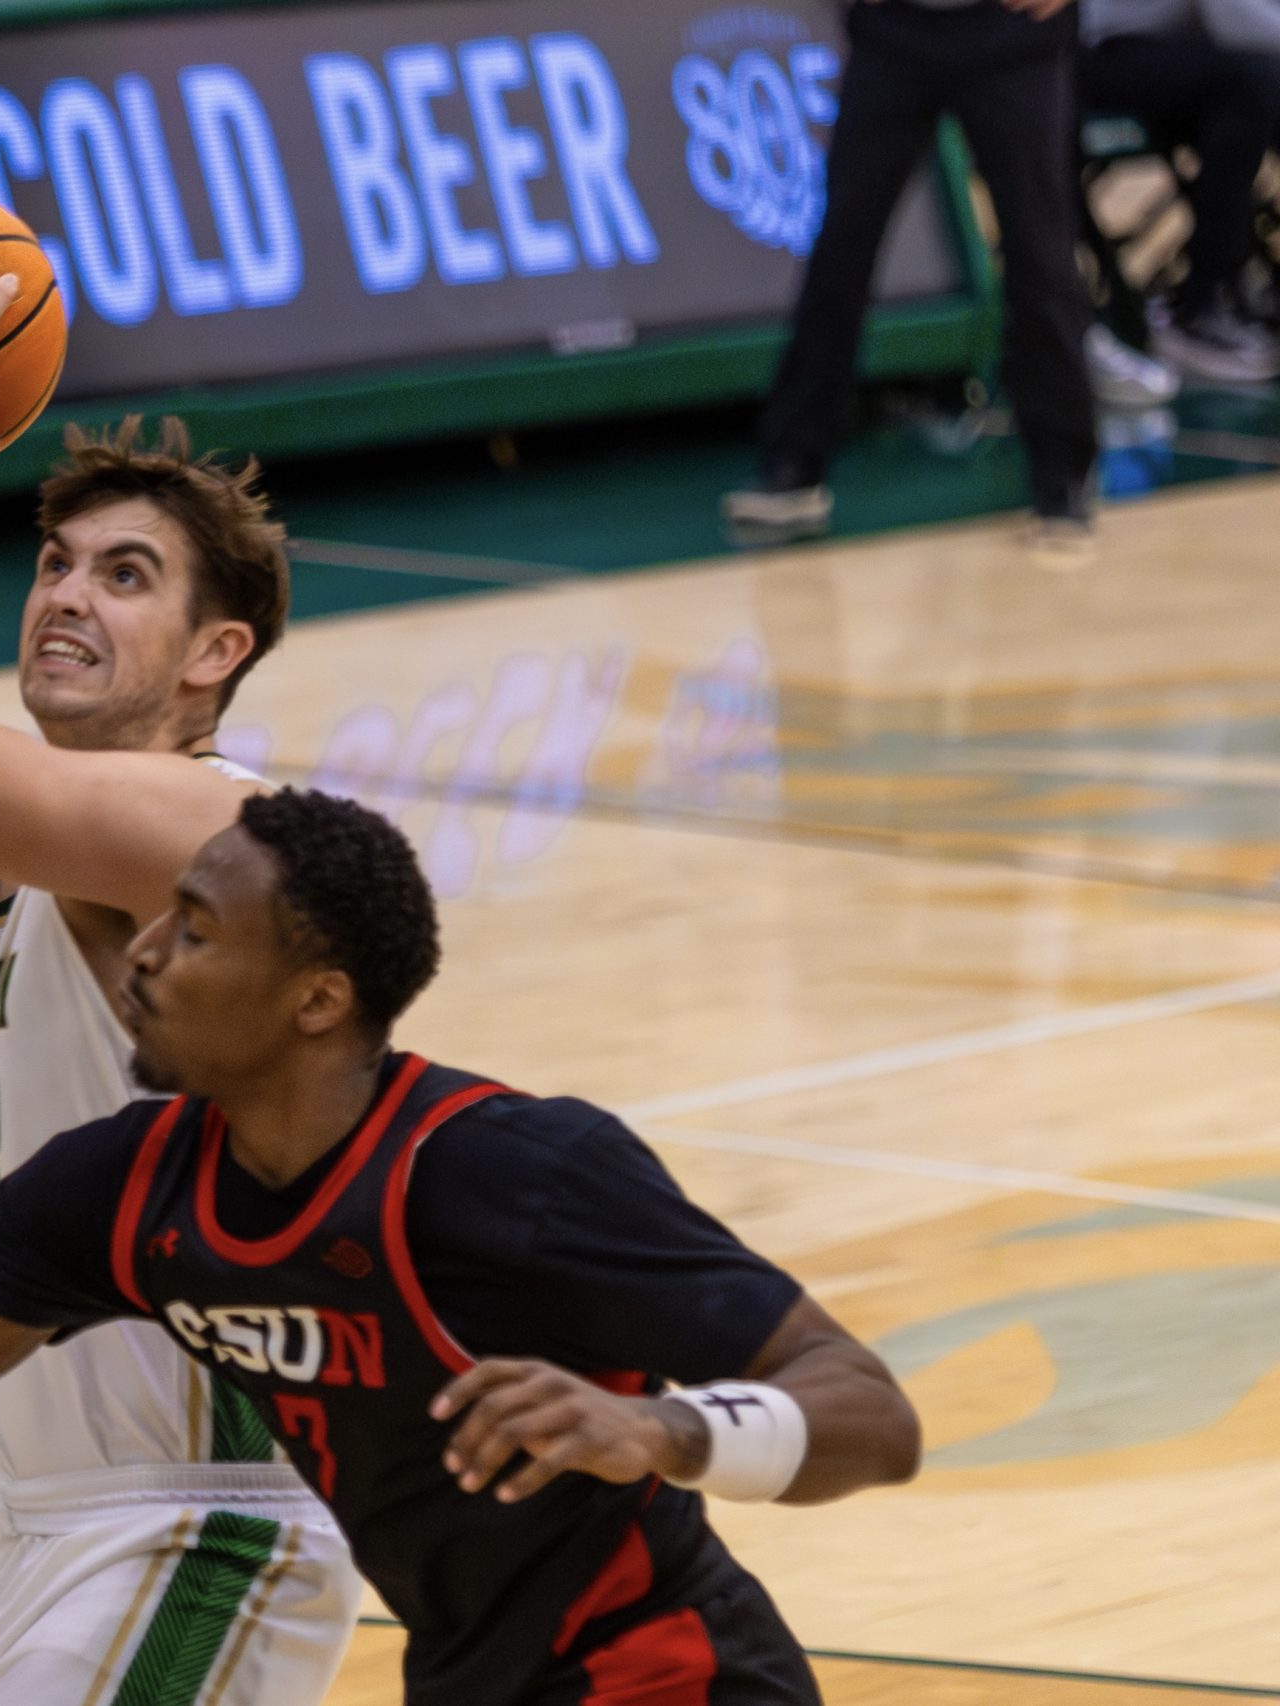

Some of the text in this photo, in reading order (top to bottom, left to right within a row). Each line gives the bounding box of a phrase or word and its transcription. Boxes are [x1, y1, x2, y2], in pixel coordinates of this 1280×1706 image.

[302, 30, 661, 295] BEER
[165, 1299, 387, 1389] CSUN
[273, 1393, 337, 1500] 7
